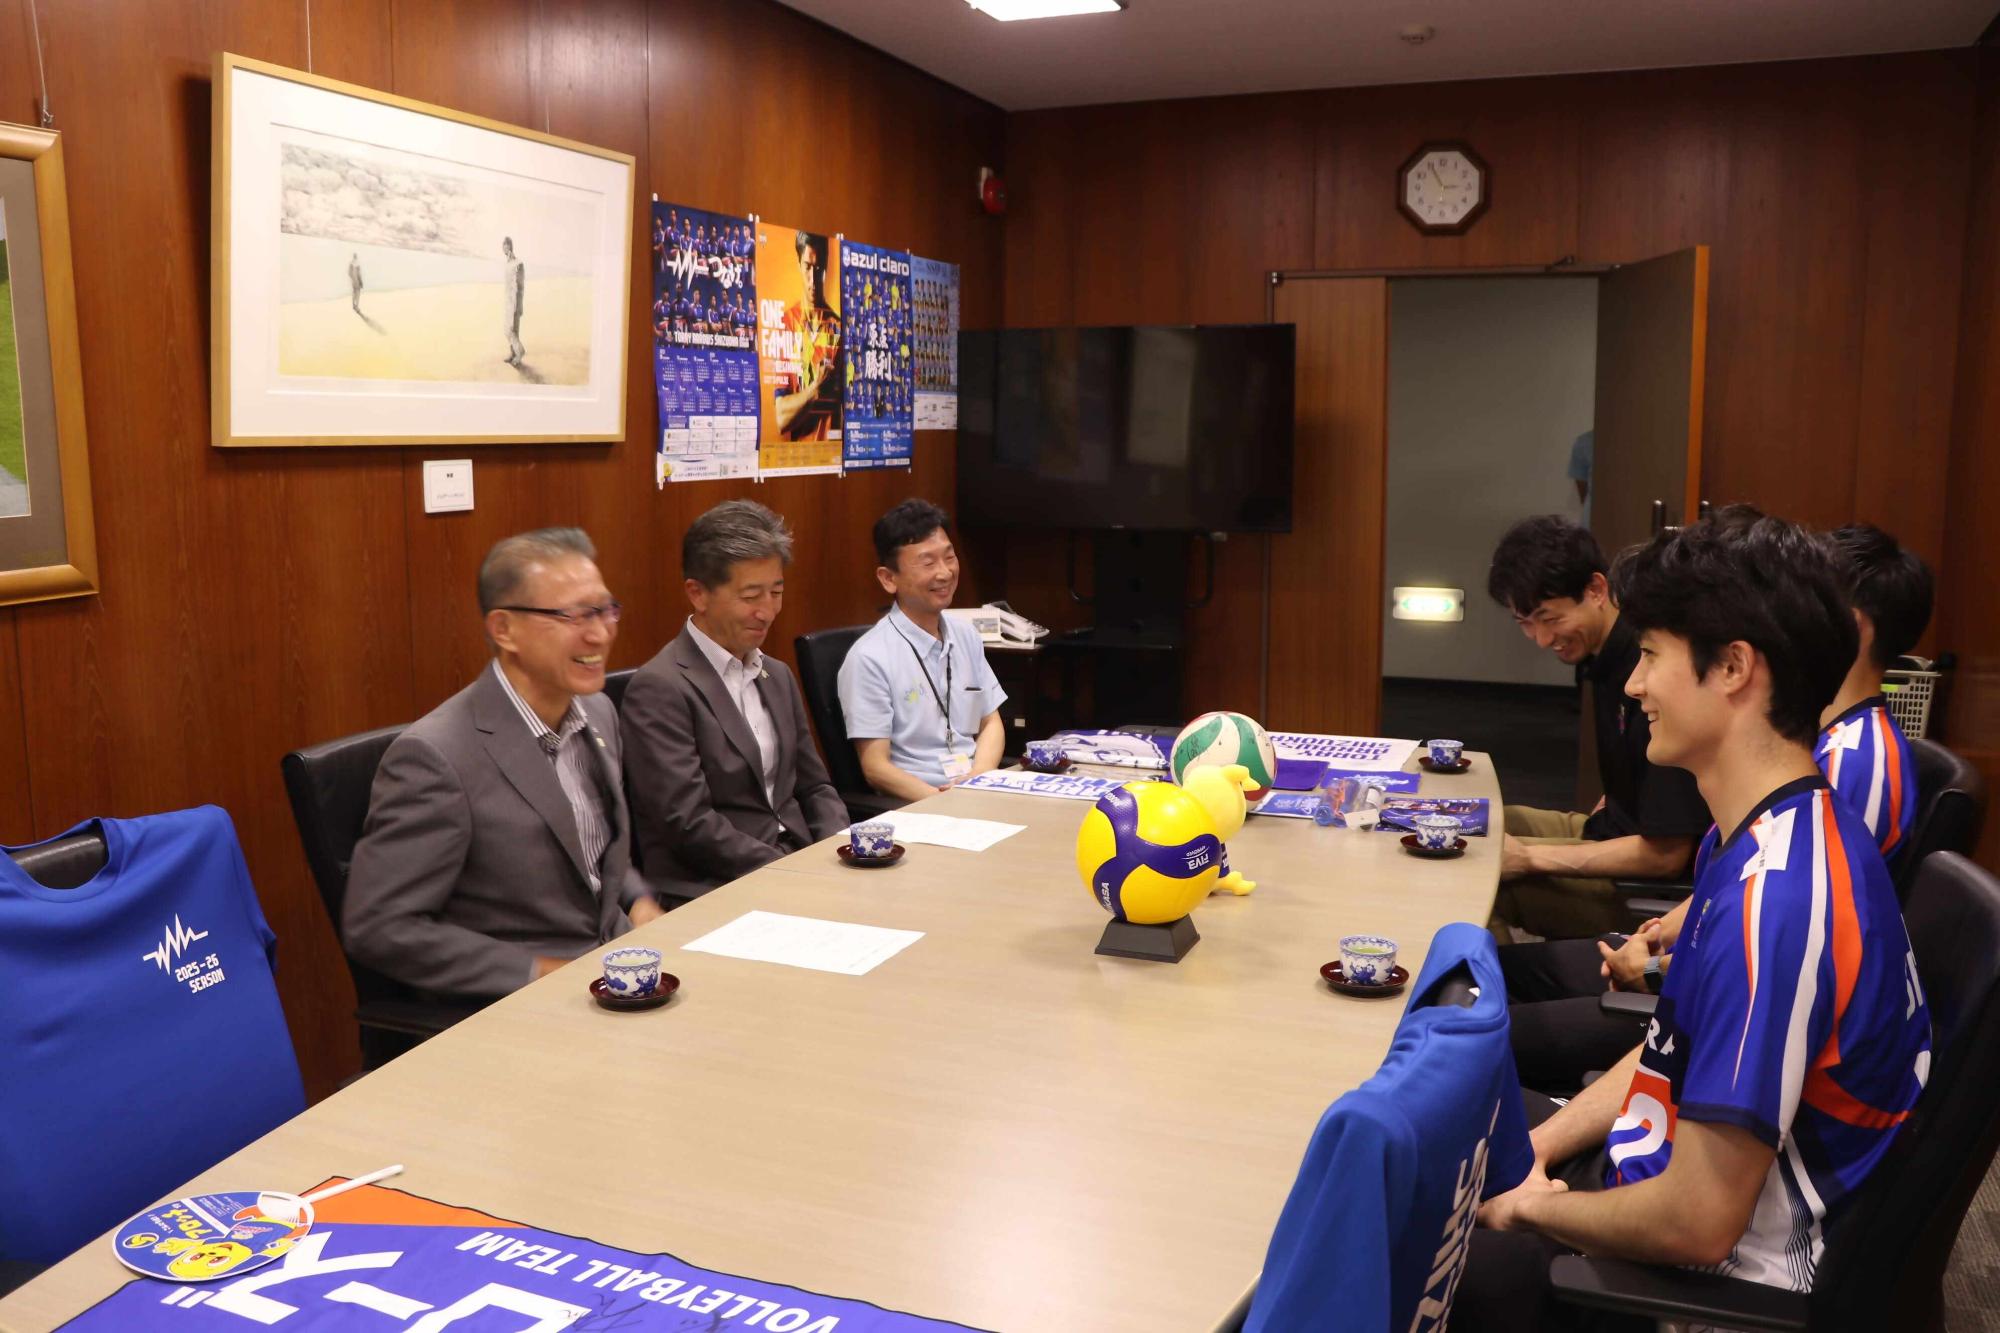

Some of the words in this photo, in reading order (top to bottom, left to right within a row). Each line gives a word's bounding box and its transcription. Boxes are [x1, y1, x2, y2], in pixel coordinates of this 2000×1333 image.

[851, 251, 878, 271] azul
[880, 256, 910, 277] claro
[760, 298, 786, 329] ONE
[761, 328, 803, 360] FAMILY
[1280, 742, 1390, 755] ARROWS
[1297, 749, 1383, 761] TORAY
[1187, 853, 1210, 870] FIVB
[174, 953, 220, 983] 2025-26
[188, 967, 226, 994] SEASON
[454, 1230, 580, 1275] TEAM
[572, 1259, 842, 1333] VOLLEYBALL
